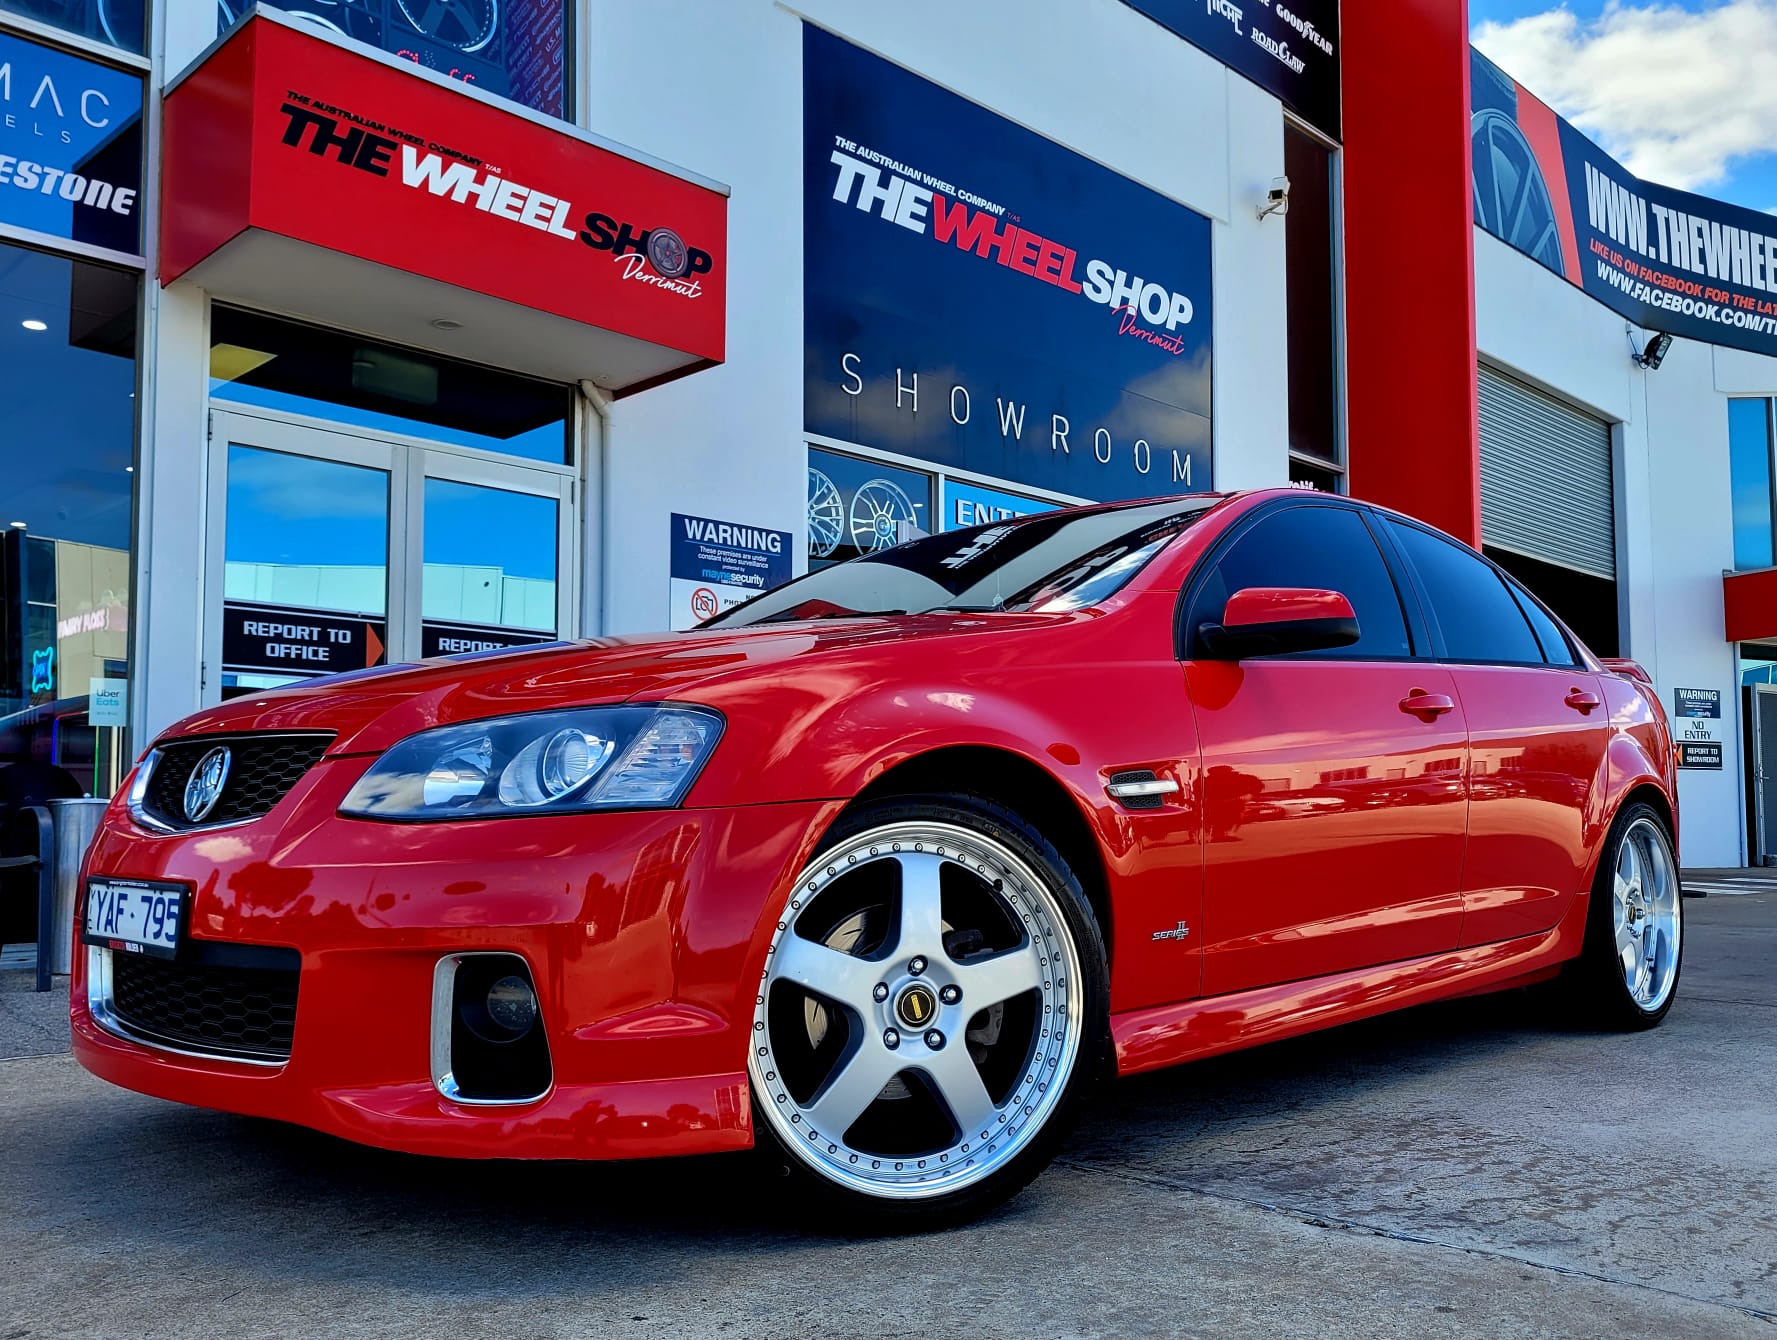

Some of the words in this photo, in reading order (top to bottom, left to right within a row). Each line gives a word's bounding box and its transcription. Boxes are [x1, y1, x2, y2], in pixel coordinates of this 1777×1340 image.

[1275, 4, 1333, 56] GOODYEAR
[287, 90, 311, 105] THE
[312, 100, 386, 132] AUSTRALIAN
[387, 127, 426, 147] WHEEL
[428, 142, 483, 166] COMPANY
[280, 102, 399, 177] THE
[402, 144, 577, 241] WHEEL
[579, 212, 713, 279] SHOP
[835, 135, 857, 153] THE
[856, 146, 922, 181] AUSTRALIAN
[922, 173, 957, 197] WHEEL
[957, 189, 1006, 216] COMPANY
[830, 150, 934, 235] THE
[932, 193, 1082, 295] WHEEL
[1082, 259, 1194, 332] SHOP
[613, 253, 703, 299] Derrimut
[1589, 237, 1610, 261] LIKE
[1610, 251, 1624, 269] US
[1624, 258, 1640, 277] ON
[1639, 266, 1704, 298] FACEBOOK
[1704, 287, 1730, 305] FOR
[1732, 294, 1756, 311] THE
[1111, 304, 1185, 356] Derrimut
[840, 353, 1193, 487] SHOWROOM
[955, 498, 1030, 528] ENT
[684, 518, 781, 553] WARNING
[700, 545, 717, 556] These
[717, 549, 742, 560] premises
[722, 556, 737, 564] video
[243, 620, 322, 642] REPORT
[327, 628, 352, 645] TO
[265, 643, 330, 662] OFFICE
[96, 689, 120, 698] Uber
[1680, 689, 1717, 700] WARNING
[1684, 730, 1712, 739] ENTRY
[1692, 721, 1704, 730] NO
[1686, 755, 1720, 763] SHOWROOM
[1687, 747, 1709, 755] REPORT
[96, 889, 128, 935] YAF
[141, 895, 181, 943] 795
[1152, 927, 1190, 941] SERIES
